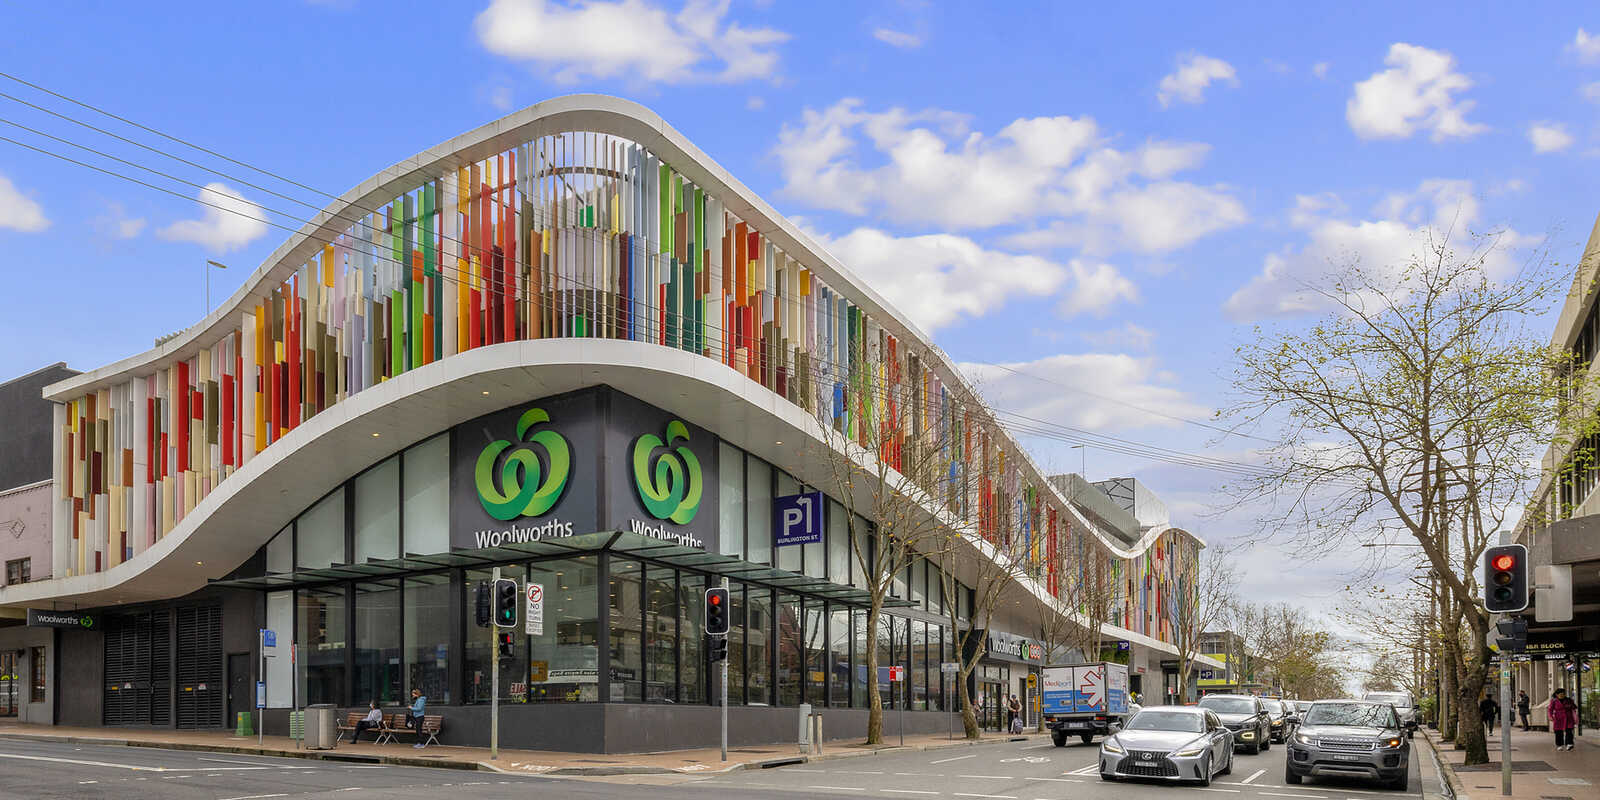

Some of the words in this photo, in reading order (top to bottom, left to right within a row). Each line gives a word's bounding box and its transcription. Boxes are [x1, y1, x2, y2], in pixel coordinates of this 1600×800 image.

[783, 508, 803, 536] P
[475, 518, 573, 549] Woolworths
[530, 602, 540, 610] NO
[37, 615, 79, 625] Woolworths
